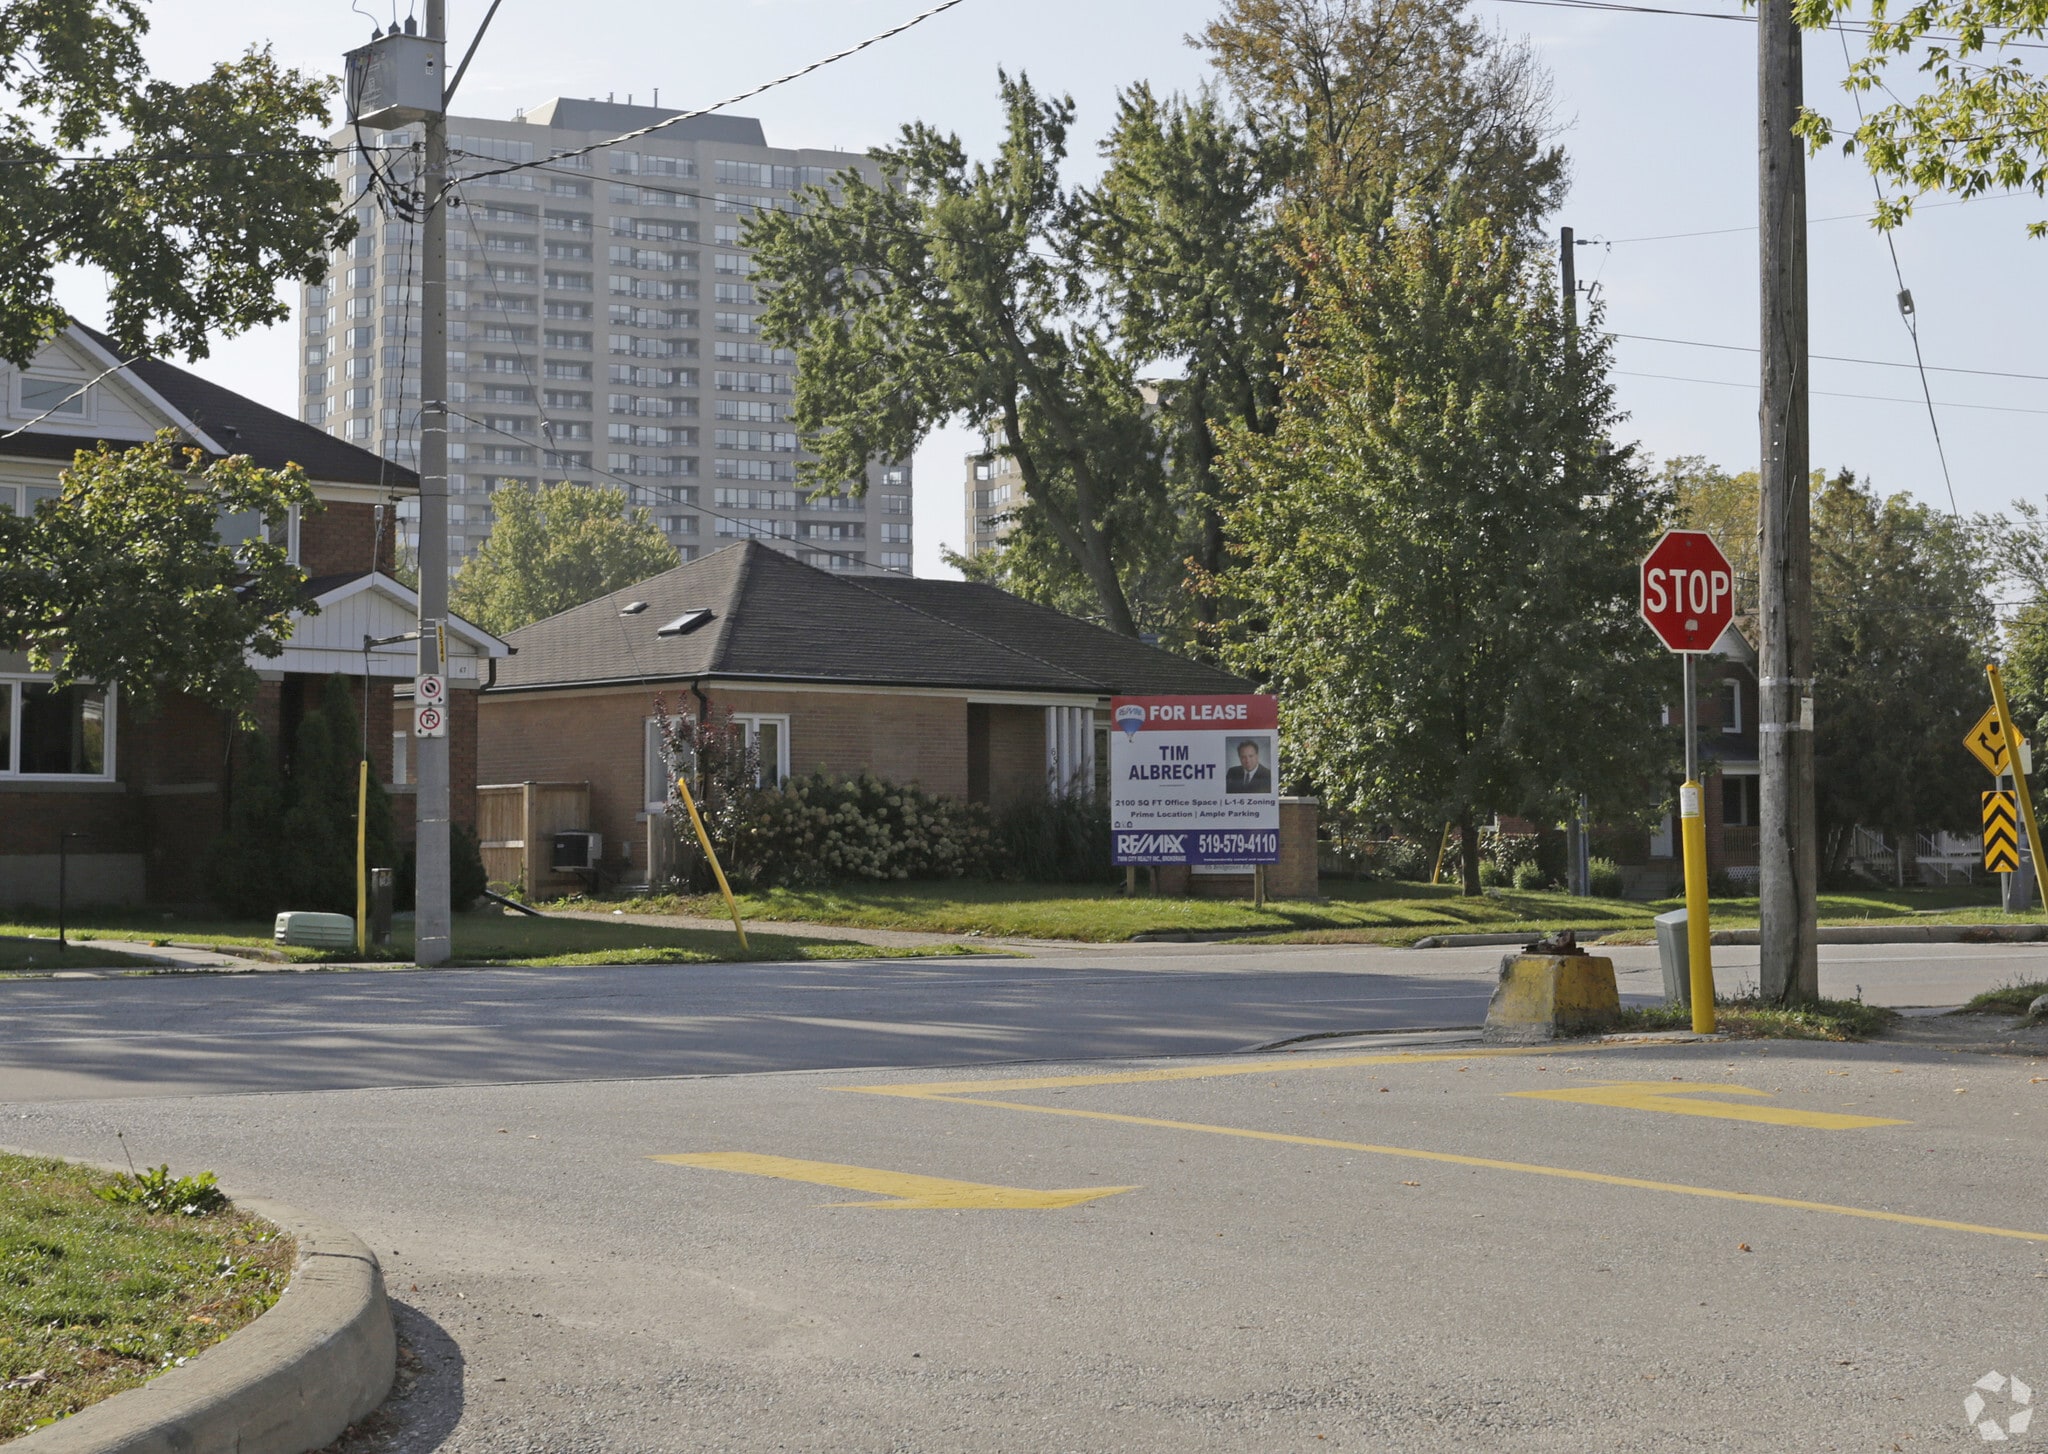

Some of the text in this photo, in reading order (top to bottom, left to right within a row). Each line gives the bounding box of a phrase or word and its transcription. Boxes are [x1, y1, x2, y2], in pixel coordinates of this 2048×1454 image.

[1646, 567, 1730, 614] STOP
[1150, 704, 1248, 721] FOR LEASE
[1159, 745, 1189, 760] TIM
[1129, 764, 1216, 780] ALBRECHT
[1192, 799, 1218, 808] Space
[1247, 799, 1276, 807] Zoning
[1199, 811, 1226, 819] Ample
[1228, 810, 1260, 819] Parking
[1117, 833, 1277, 854] RE/MAX 519-579-4110
